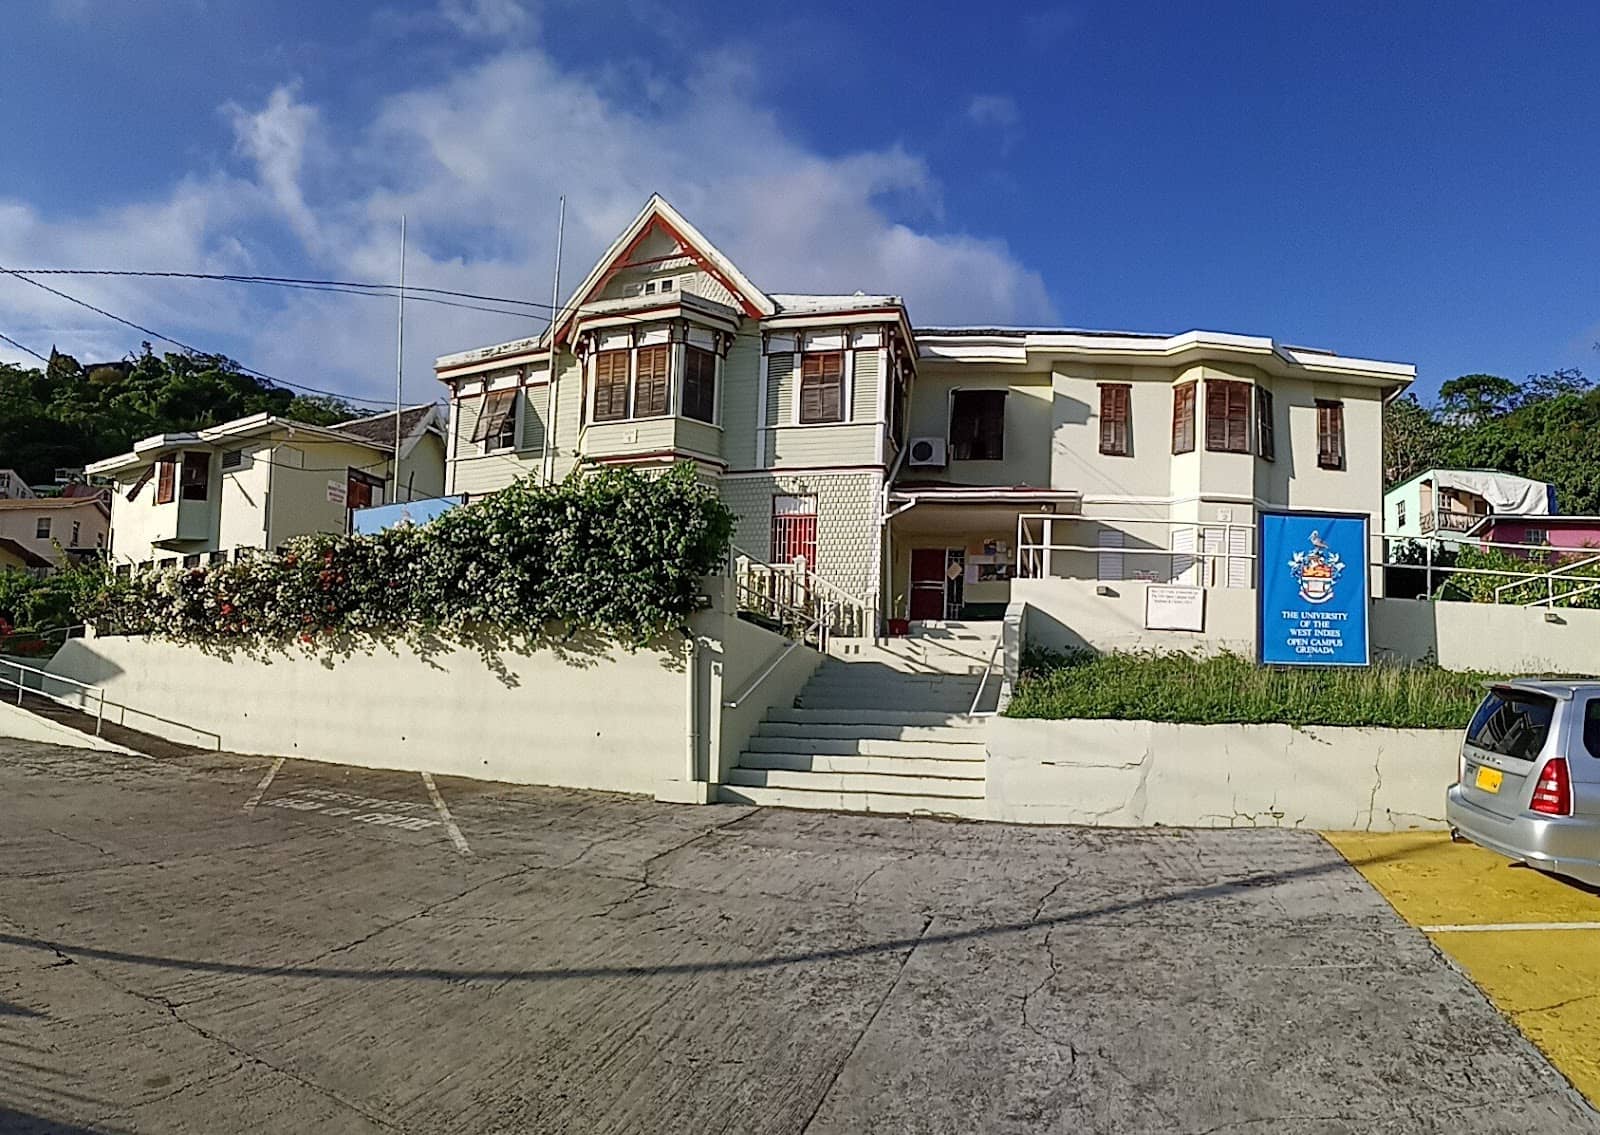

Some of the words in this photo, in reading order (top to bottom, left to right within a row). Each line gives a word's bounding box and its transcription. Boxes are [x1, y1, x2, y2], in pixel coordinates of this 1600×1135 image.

[1281, 611, 1299, 619] THE
[1301, 611, 1348, 620] UNIVERSITY
[1300, 620, 1311, 628] OF
[1313, 620, 1330, 628] THE
[1290, 628, 1312, 636] WEST
[1314, 629, 1341, 637] INDIES
[1287, 638, 1309, 646] OPEN
[1310, 638, 1343, 647] CAMPUS
[1295, 646, 1335, 654] GRENADA
